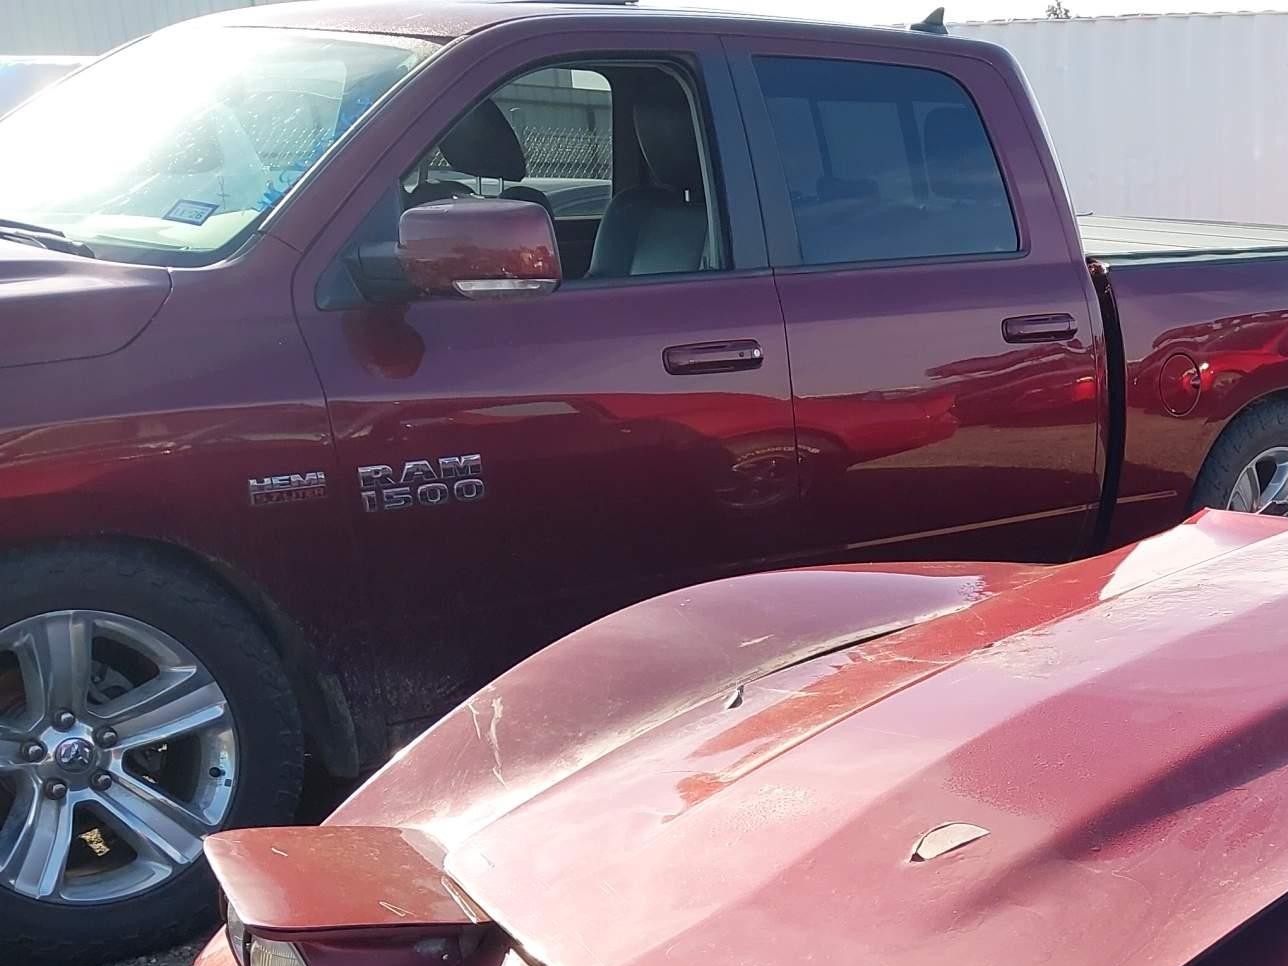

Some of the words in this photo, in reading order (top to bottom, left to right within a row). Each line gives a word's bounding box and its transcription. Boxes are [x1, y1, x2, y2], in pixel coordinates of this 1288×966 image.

[248, 471, 326, 492] HEMI
[357, 453, 483, 489] RAM
[360, 478, 486, 513] 1500
